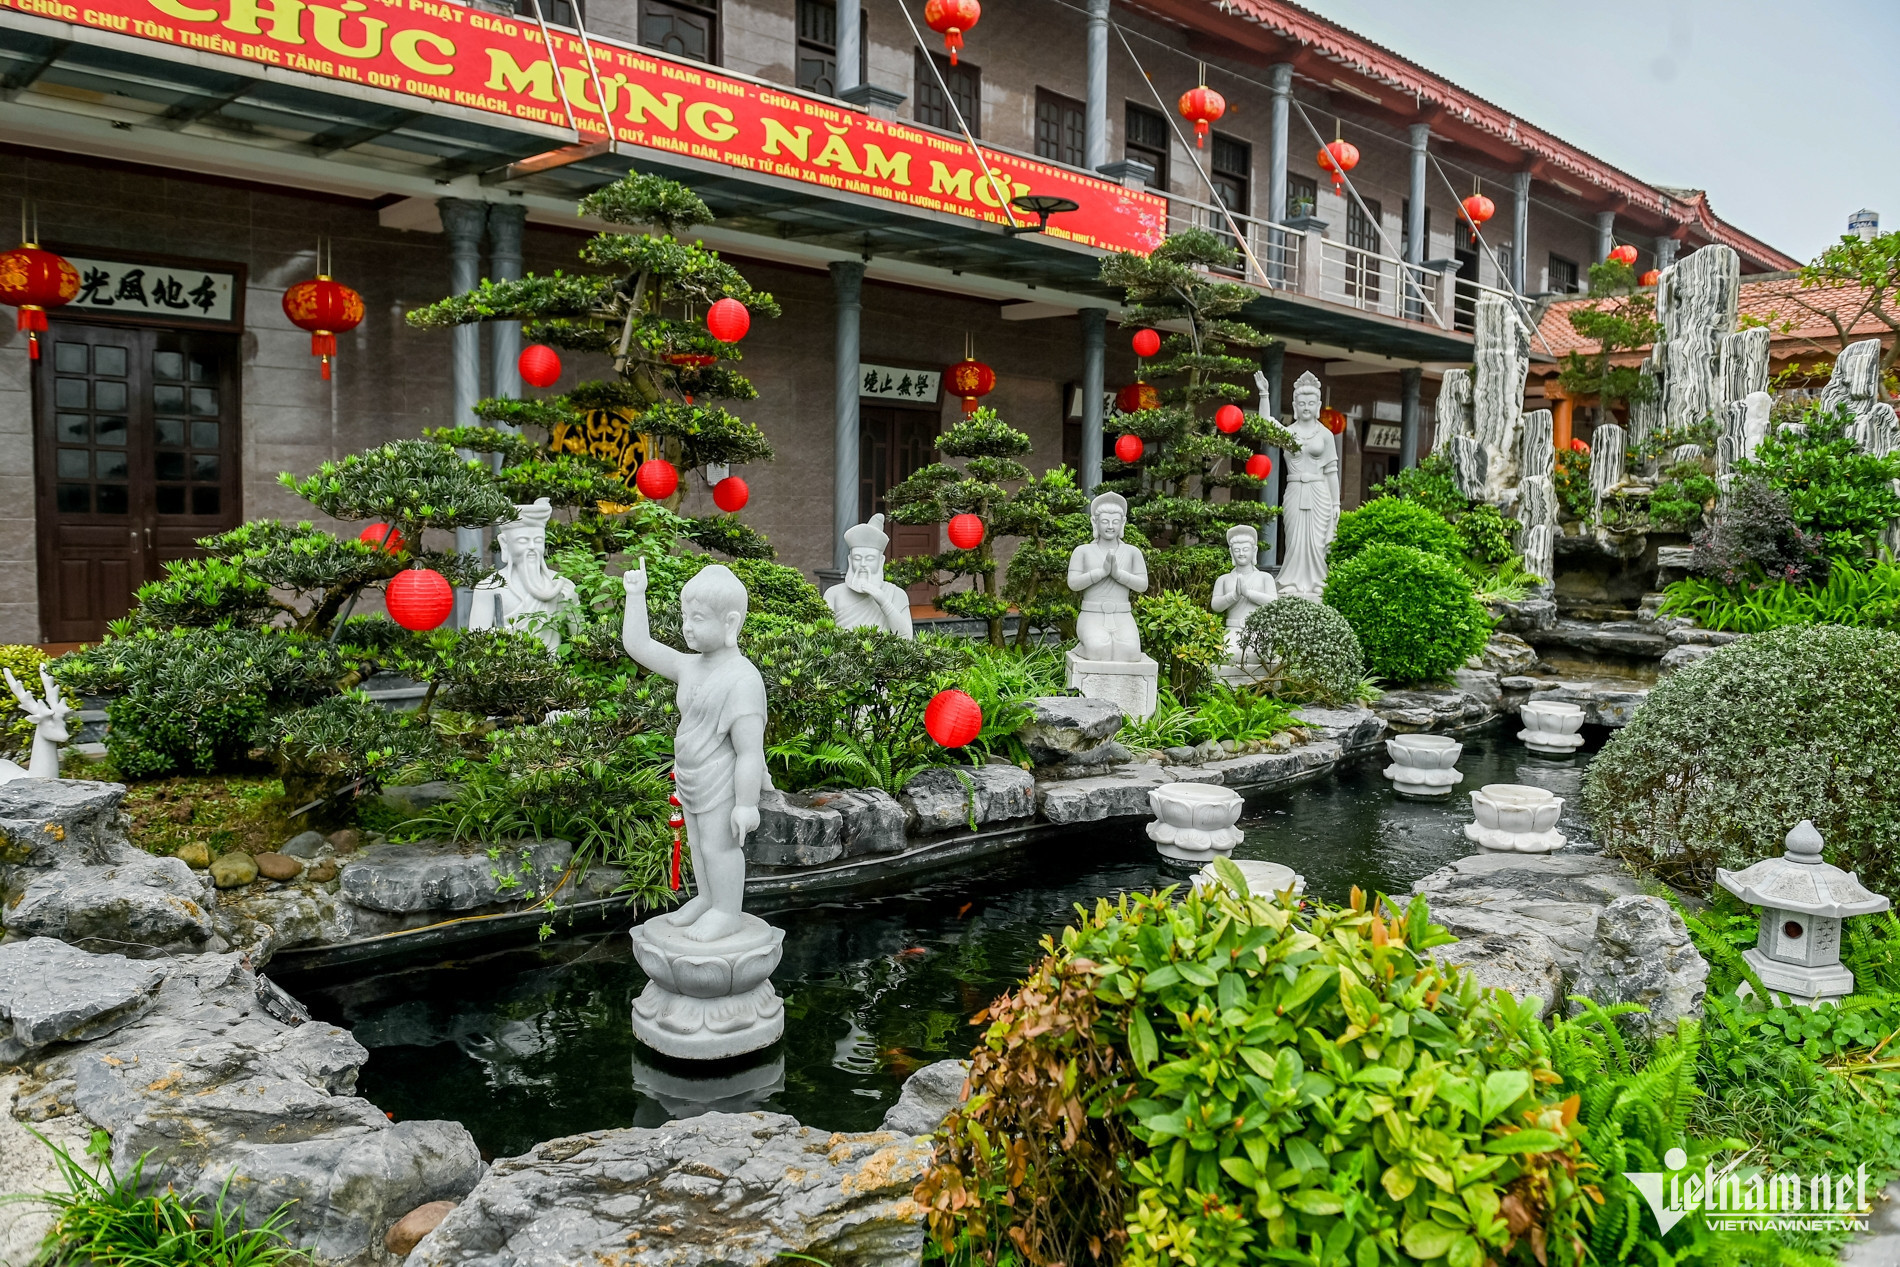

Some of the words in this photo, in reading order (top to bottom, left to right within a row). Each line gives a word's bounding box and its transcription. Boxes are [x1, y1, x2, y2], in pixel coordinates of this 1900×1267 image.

[83, 9, 130, 31] CHƯ
[132, 19, 174, 42] TÔN
[178, 29, 237, 55] THIỀN
[241, 43, 280, 63] ĐỨC
[285, 52, 333, 76] TĂNG
[368, 71, 401, 89] QUÝ
[406, 79, 451, 101] QUAN
[516, 104, 548, 121] CHƯ
[652, 135, 689, 154] NHÂN
[724, 151, 755, 169] PHẬT
[758, 158, 774, 172] TỬ
[802, 169, 817, 183] XA
[820, 173, 843, 189] MỘT
[845, 178, 870, 194] NĂM
[872, 186, 893, 199] MỚI
[895, 190, 908, 202] VÔ
[910, 194, 941, 209] LƯỢNG
[943, 202, 956, 214] AN
[983, 211, 996, 222] VÔ
[1072, 233, 1089, 244] NHƯ
[409, 0, 464, 23] PHẬT
[470, 14, 518, 37] GIÁO
[617, 53, 657, 75] TỈNH
[661, 65, 701, 85] NAM
[705, 78, 744, 97] ĐỊNH
[760, 92, 800, 112] CHÙA
[804, 104, 840, 122] BÌNH
[843, 114, 853, 126] A
[926, 136, 963, 156] THỊNH
[484, 48, 739, 142] MỪNG
[760, 117, 912, 186] NĂM
[928, 160, 1032, 215] MỚI
